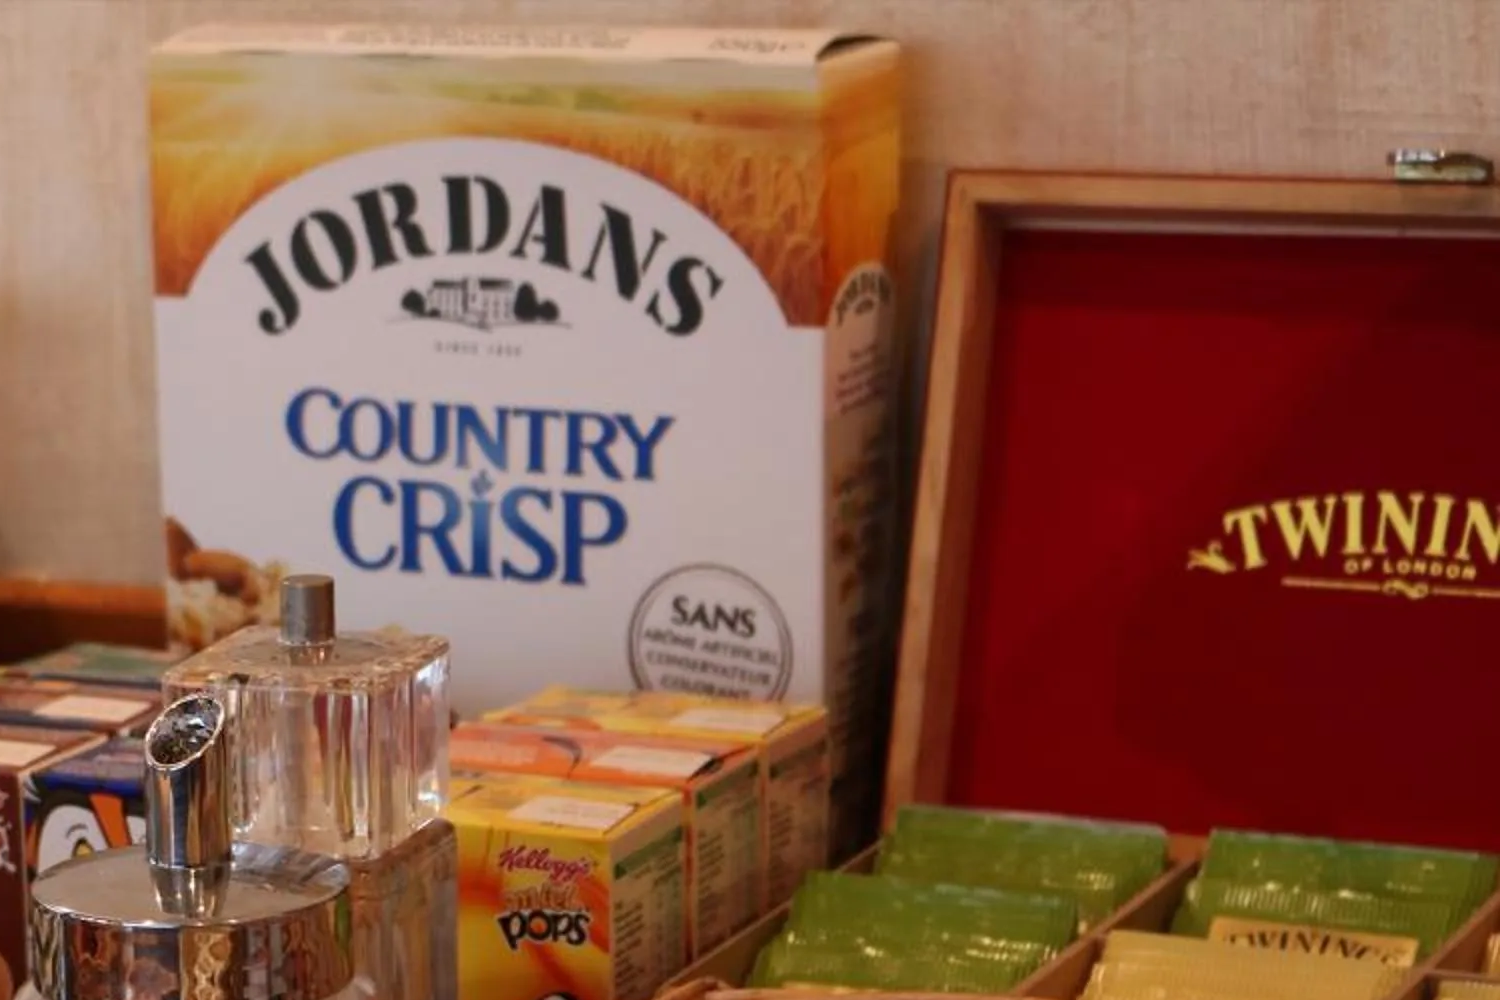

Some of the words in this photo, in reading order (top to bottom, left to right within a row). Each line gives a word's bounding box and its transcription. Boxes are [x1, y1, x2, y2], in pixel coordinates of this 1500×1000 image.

[244, 174, 724, 337] JORDANS
[286, 387, 673, 481] COUNTRY
[1343, 558, 1373, 575] OF
[1383, 559, 1476, 580] LONDON
[671, 594, 756, 638] SANS
